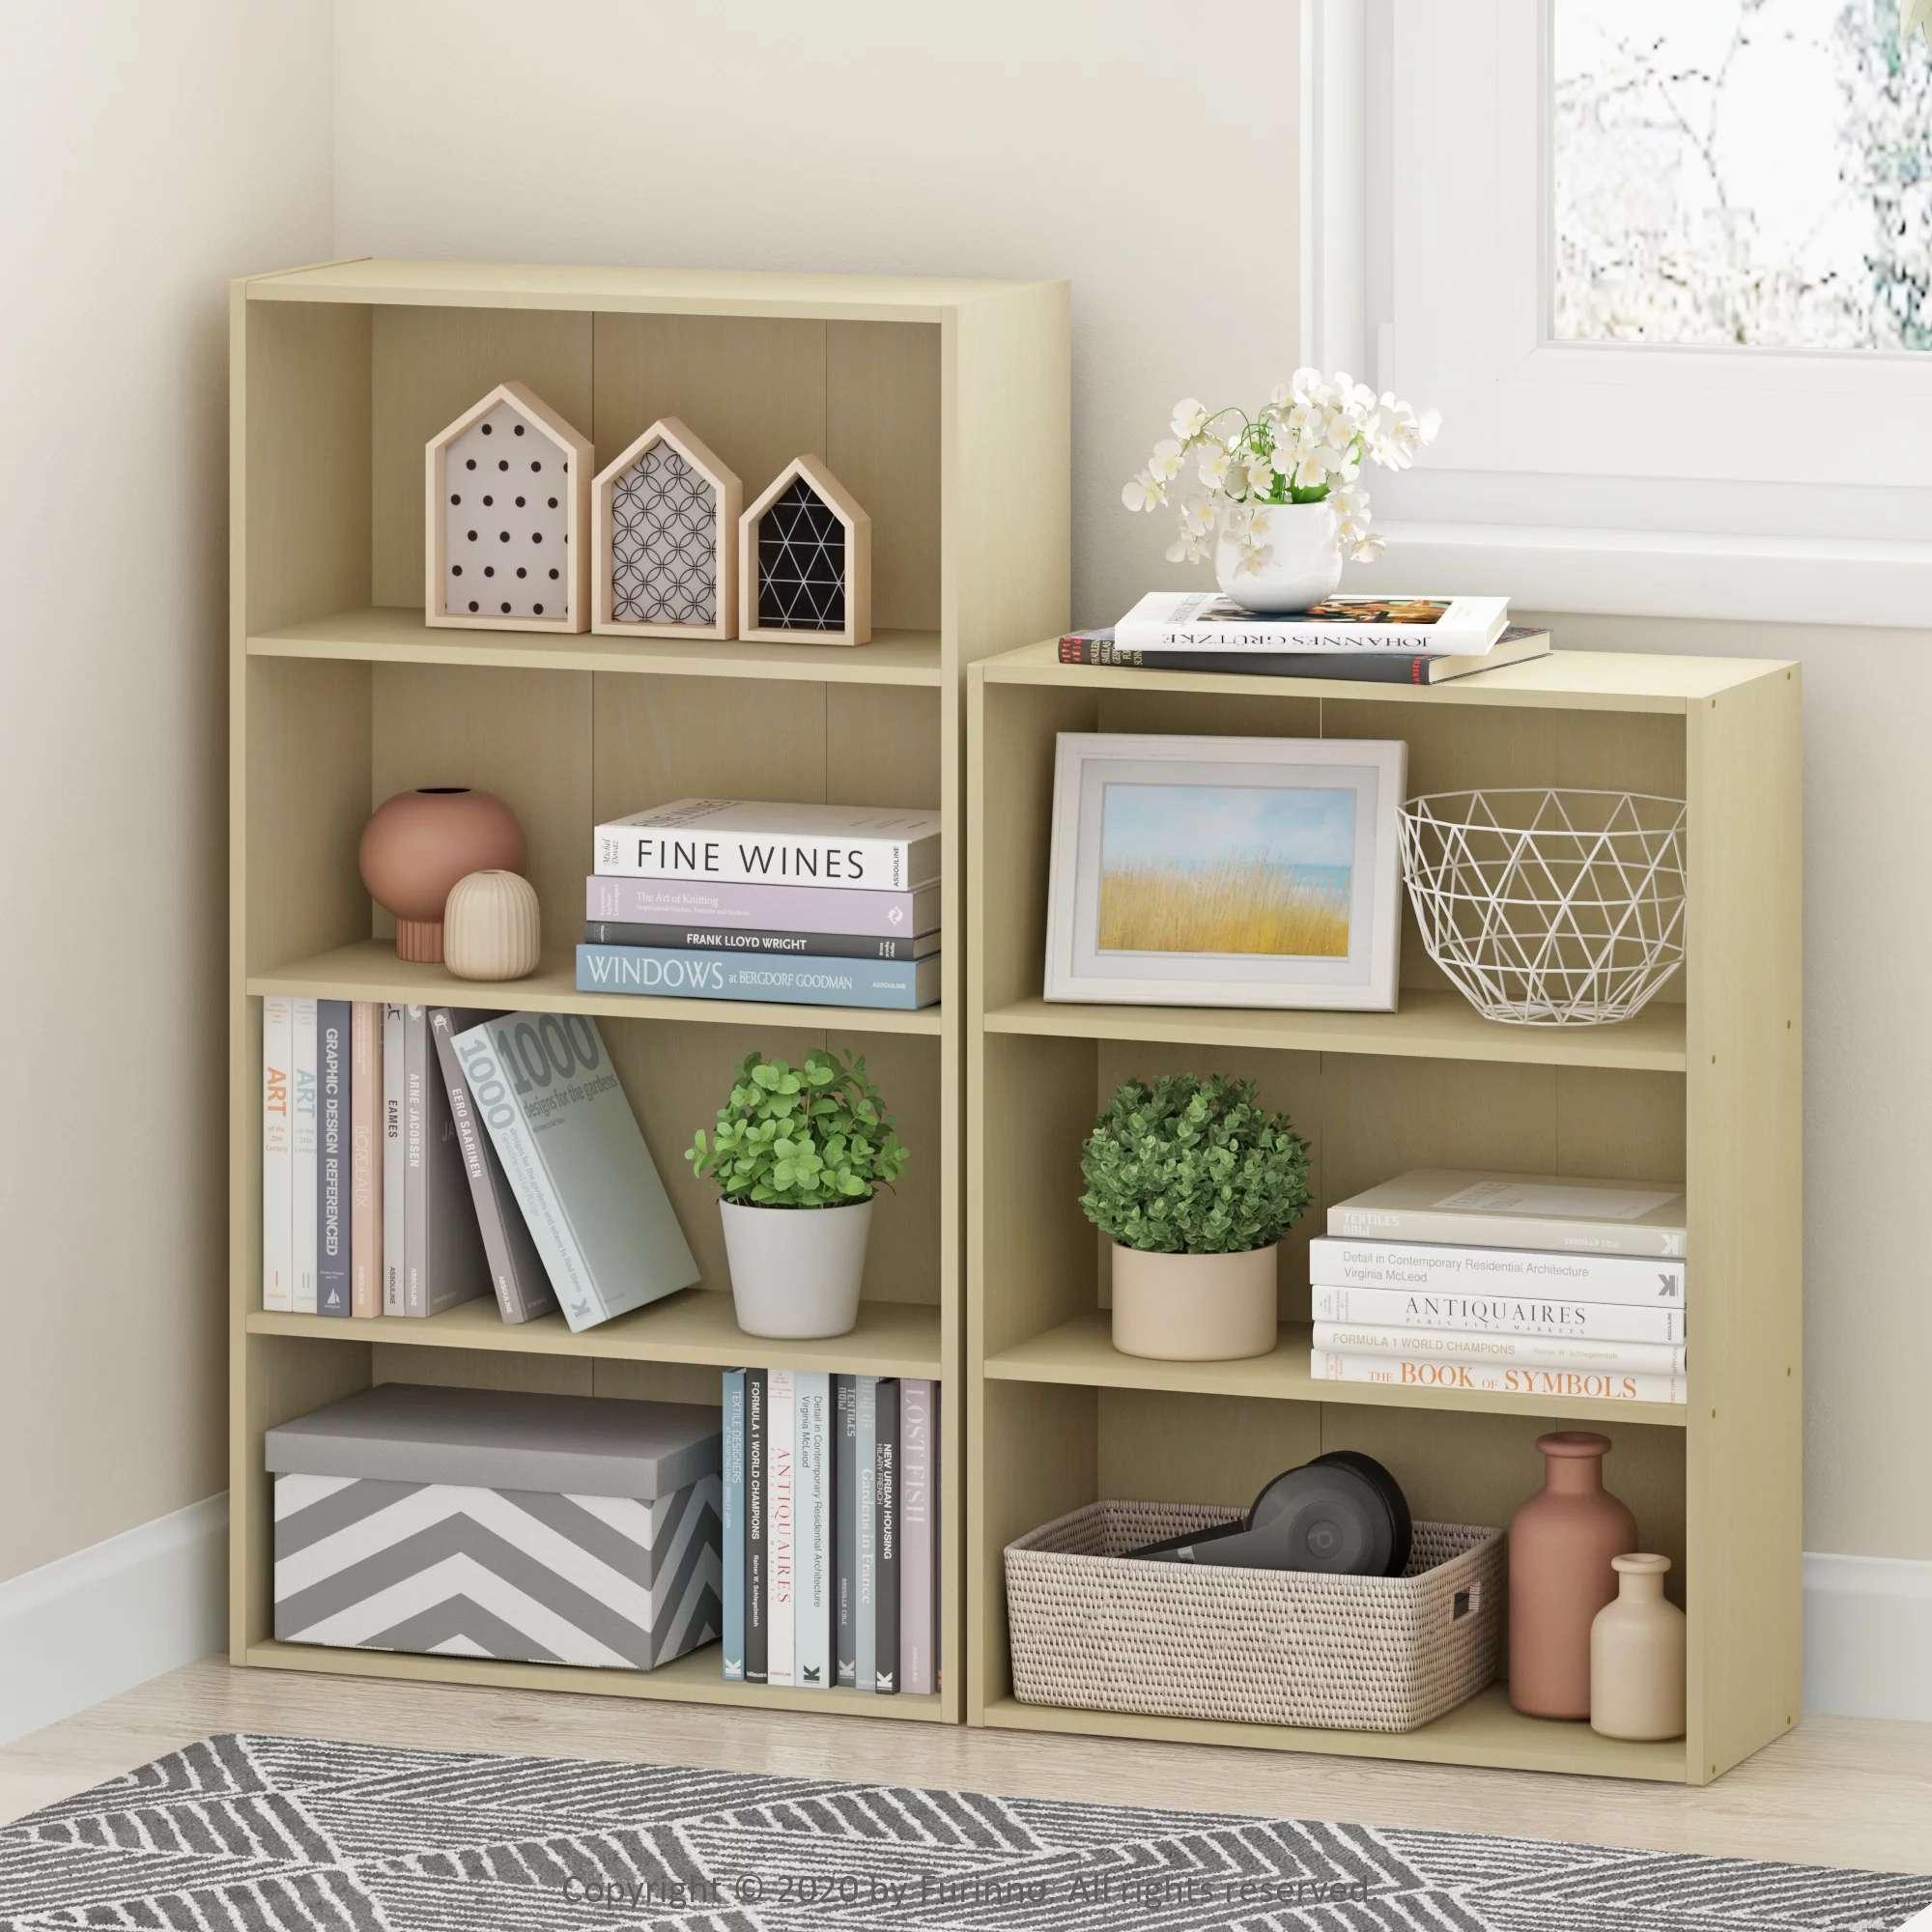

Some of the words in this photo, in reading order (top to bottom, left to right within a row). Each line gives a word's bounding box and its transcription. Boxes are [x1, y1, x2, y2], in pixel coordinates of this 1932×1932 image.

[1292, 637, 1432, 647] JOHANNES
[602, 837, 611, 866] Michel
[639, 839, 720, 871] FINE
[739, 844, 864, 879] WINES
[637, 892, 654, 902] The
[656, 893, 670, 902] Art
[671, 894, 682, 903] of
[682, 895, 719, 907] Knitting
[687, 933, 723, 946] FRANK
[724, 936, 759, 948] LLOYD
[762, 938, 808, 951] WRIGHT
[585, 954, 724, 989] WINDOWS
[728, 974, 737, 983] at
[739, 971, 794, 986] BERGDORF
[796, 974, 853, 990] GOODMAN
[872, 981, 906, 990] ASSOULINE
[326, 1028, 338, 1094] GRAPHIC
[497, 1013, 600, 1095] 1000
[267, 1066, 287, 1118] ART
[296, 1068, 316, 1119] ART
[410, 1073, 419, 1104] ARNE
[459, 1038, 515, 1130] 1000
[524, 1095, 557, 1119] designs
[554, 1089, 570, 1107] for
[567, 1083, 584, 1102] the
[583, 1074, 617, 1101] gardens
[326, 1099, 338, 1154] DESIGN
[388, 1100, 398, 1138] EAMES
[410, 1107, 419, 1168] JACOBSEN
[452, 1088, 467, 1118] EERO
[460, 1121, 482, 1179] SAARINEN
[510, 1127, 526, 1155] designs
[355, 1125, 368, 1208] BORDEAUX
[526, 1168, 535, 1180] the
[326, 1159, 338, 1256] REFERENCED
[529, 1181, 547, 1211] gardens
[545, 1211, 554, 1226] and
[551, 1225, 563, 1249] where
[1344, 1212, 1400, 1227] TEXTILES
[563, 1257, 575, 1273] find
[570, 1272, 582, 1293] them
[1344, 1251, 1373, 1264] Detail
[1376, 1252, 1385, 1264] in
[1388, 1254, 1463, 1271] Contemporary
[1465, 1259, 1522, 1273] Residential
[1526, 1263, 1589, 1277] Architecture
[1344, 1267, 1382, 1282] Virginia
[1385, 1269, 1428, 1283] McLeod
[498, 1275, 513, 1314] ASSOULINE
[1406, 1296, 1585, 1324] ANTIQUAIRES
[1333, 1333, 1389, 1347] FORMULA
[1392, 1338, 1397, 1348] 1
[1401, 1338, 1443, 1350] WORLD
[1446, 1341, 1516, 1355] CHAMPIONS
[1406, 1318, 1451, 1326] PARIS
[1514, 1324, 1584, 1335] MARKETS
[1368, 1371, 1394, 1382] THE
[1401, 1362, 1475, 1388] BOOK
[1481, 1378, 1498, 1389] OF
[1505, 1369, 1636, 1399] SYMBOLS
[731, 1389, 741, 1427] TEXTILE
[752, 1382, 760, 1431] FORMULA
[801, 1396, 810, 1430] Virginia
[847, 1388, 856, 1437] TEXTILES
[906, 1389, 924, 1457] LOST
[814, 1422, 822, 1433] in
[732, 1430, 741, 1484] DESIGNERS
[752, 1440, 760, 1478] WORLD
[802, 1432, 810, 1468] McLeod
[812, 1435, 822, 1499] Contemporary
[752, 1480, 760, 1540] CHAMPIONS
[862, 1468, 874, 1531] Gardens
[906, 1464, 924, 1522] FISH
[775, 1448, 790, 1603] ANTIQUAIRES
[862, 1533, 874, 1549] in
[884, 1510, 893, 1560] HOUSING
[862, 1553, 874, 1605] France
